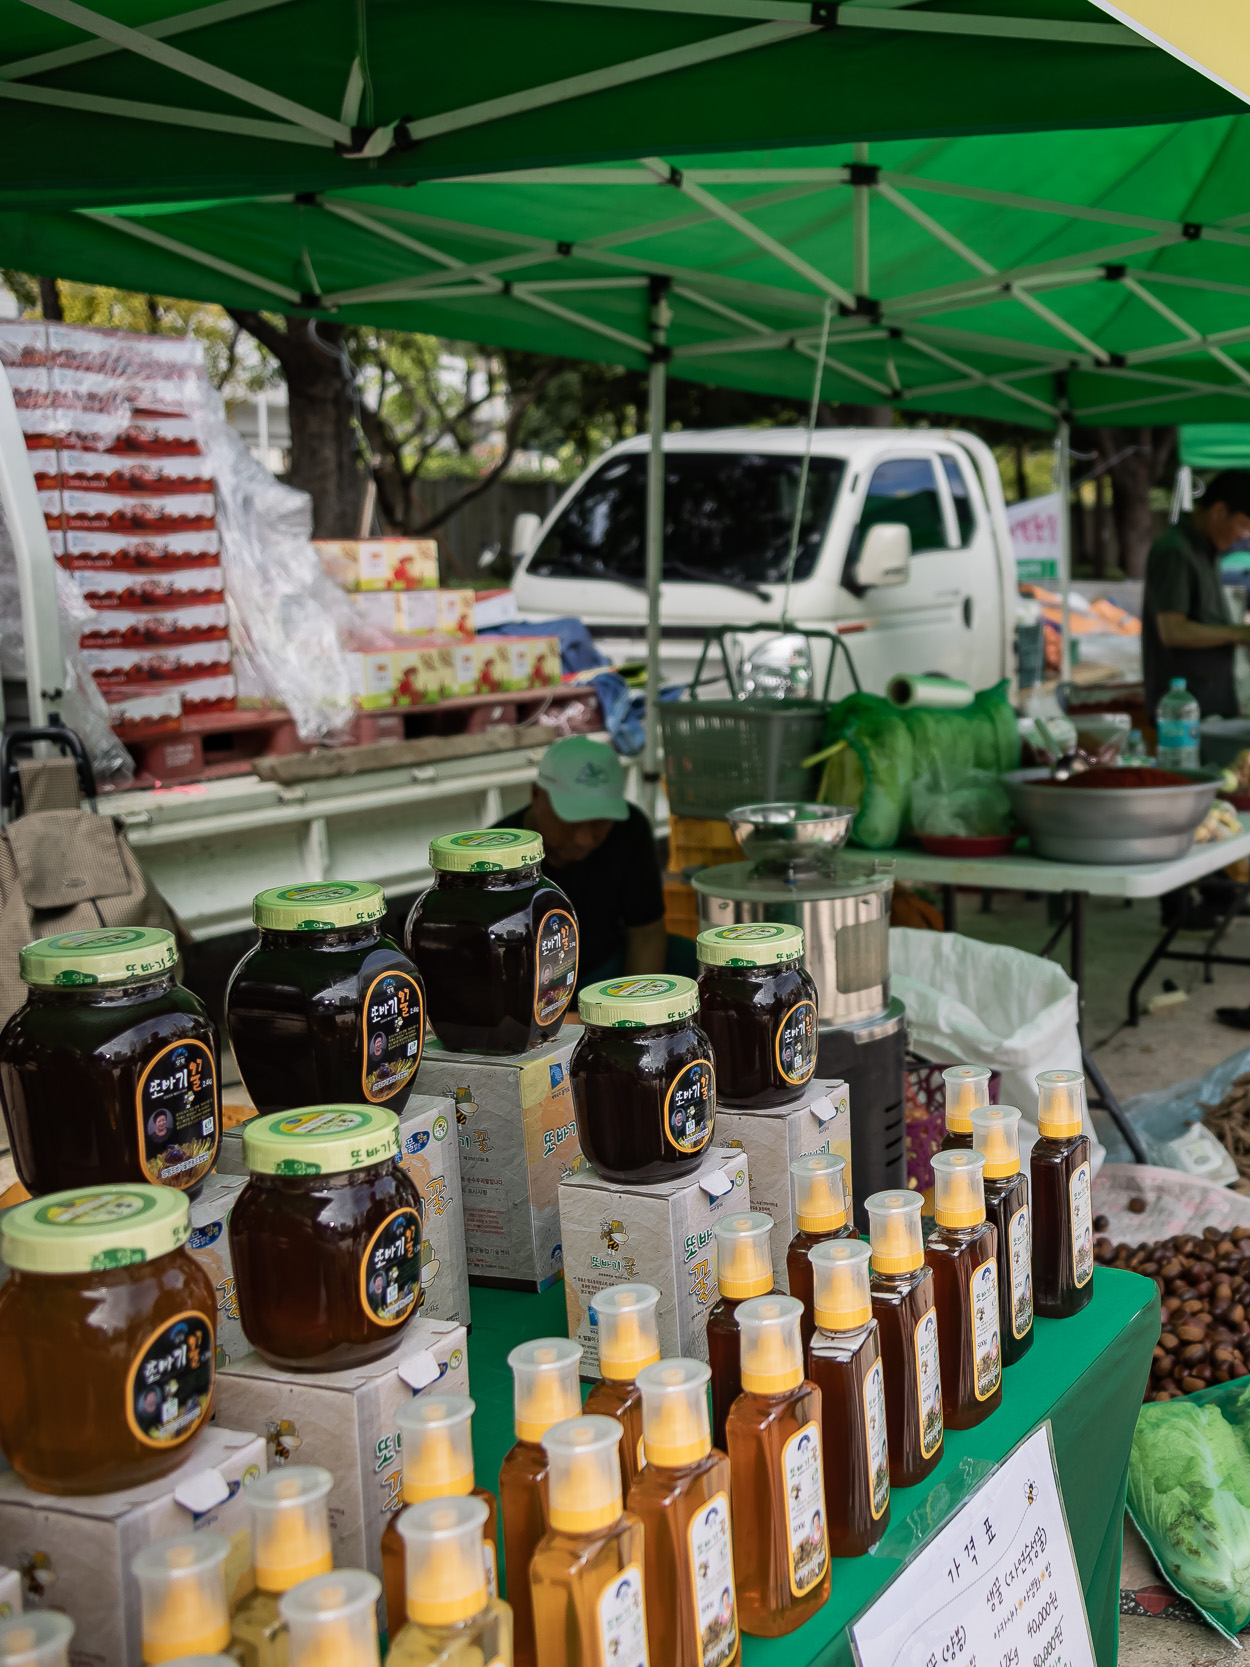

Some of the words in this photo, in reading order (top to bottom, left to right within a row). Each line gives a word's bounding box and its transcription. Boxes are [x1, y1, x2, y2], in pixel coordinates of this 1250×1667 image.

[542, 933, 561, 956] 또바기
[126, 958, 166, 979] 또바기
[371, 997, 398, 1022] 또바기
[398, 988, 410, 1017] 꿀
[785, 1021, 805, 1043] 또바기
[150, 1069, 188, 1099] 또바기
[190, 1058, 202, 1091] 꿀
[676, 1082, 700, 1106] 또바기
[701, 1074, 709, 1100] 꿀
[351, 1140, 391, 1166] 또바기
[473, 1131, 494, 1154] 꿀
[425, 1176, 453, 1217] 꿀
[375, 1236, 405, 1269] 또바기
[406, 1225, 415, 1258] 꿀
[685, 1229, 713, 1263] 또바
[591, 1256, 621, 1272] 또바기
[623, 1256, 640, 1276] 꿀
[689, 1259, 718, 1303] 꿀
[986, 1576, 1004, 1613] 생꿀
[942, 1625, 967, 1662] (양봉)
